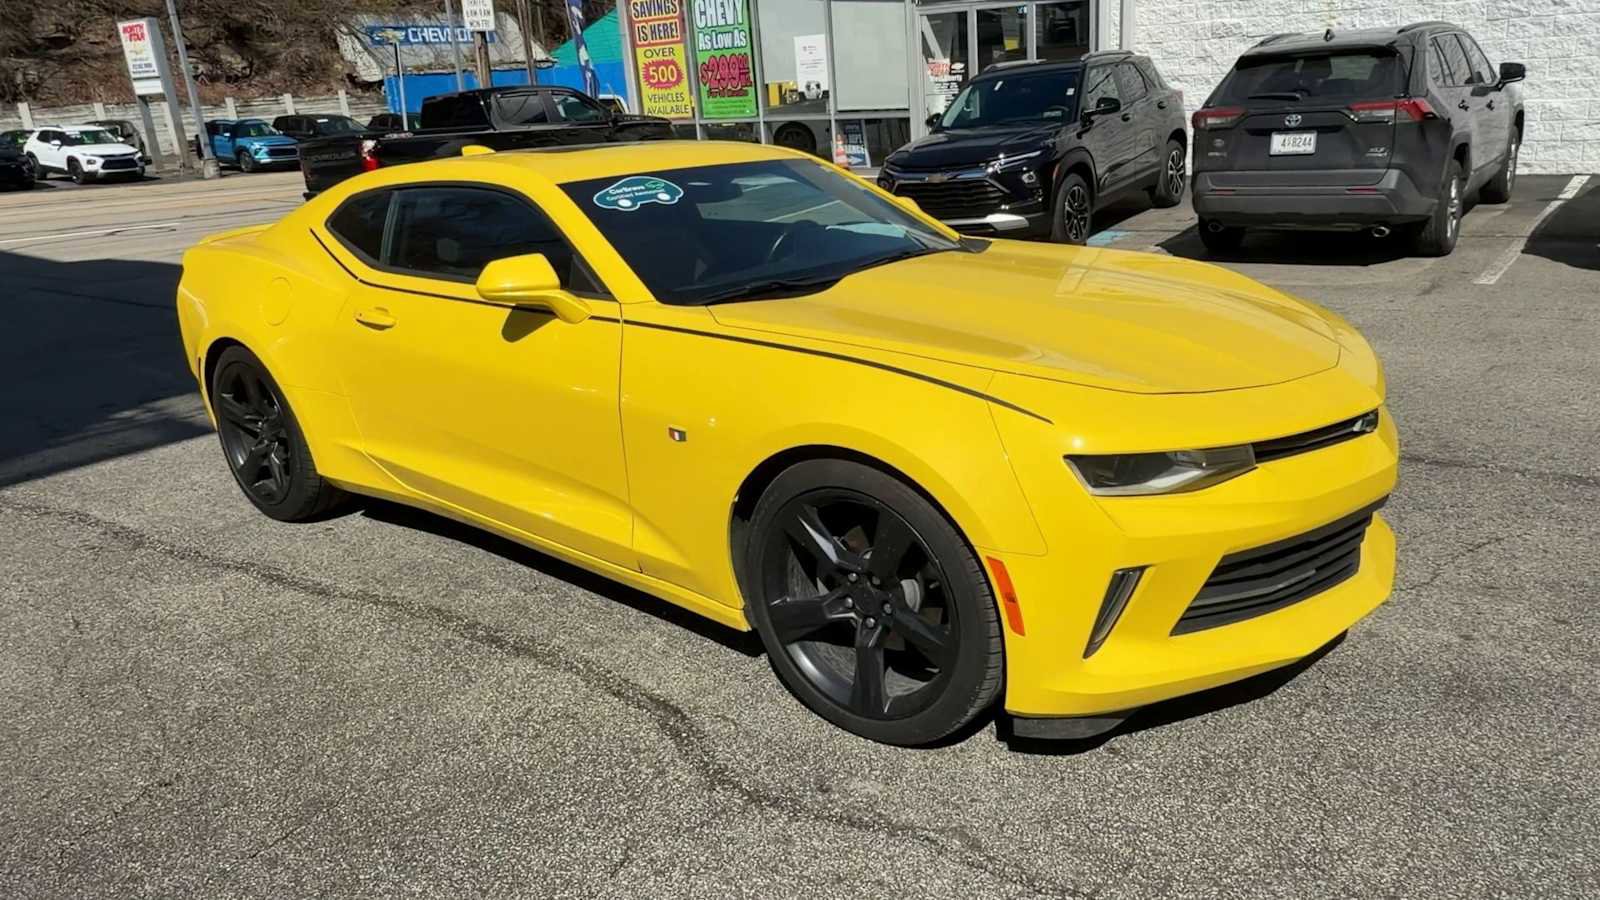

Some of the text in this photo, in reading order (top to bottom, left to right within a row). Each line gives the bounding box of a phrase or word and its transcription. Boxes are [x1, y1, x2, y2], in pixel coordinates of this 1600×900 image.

[632, 0, 678, 19] SAVINGS
[695, 0, 743, 29] CHEVY
[407, 27, 490, 42] CHEVOL
[637, 21, 679, 42] IS HERE!
[643, 47, 676, 58] OVER
[649, 65, 677, 83] 500
[647, 92, 685, 103] VEHICLES
[646, 104, 689, 115] AVAILABLE
